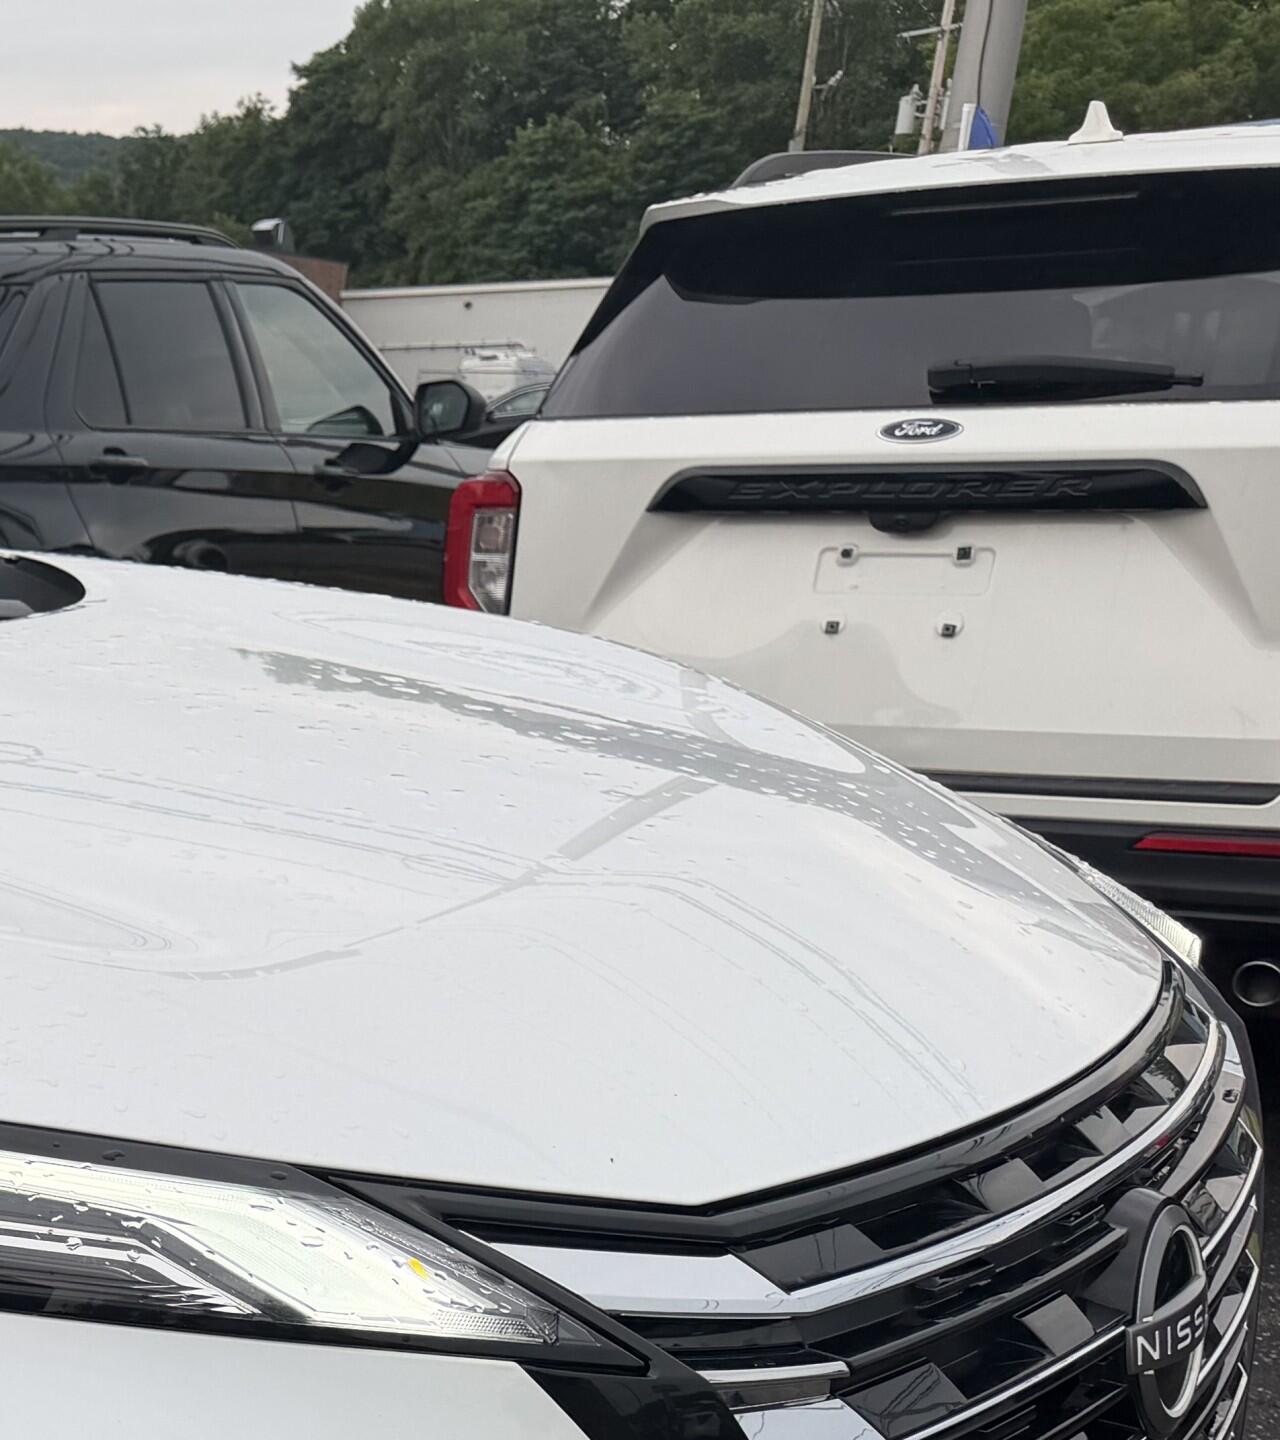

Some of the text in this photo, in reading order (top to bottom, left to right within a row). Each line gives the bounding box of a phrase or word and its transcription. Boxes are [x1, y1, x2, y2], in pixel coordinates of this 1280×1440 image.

[893, 420, 945, 437] Ford
[727, 479, 1094, 499] EXPLORER
[1136, 1304, 1206, 1366] NISS
